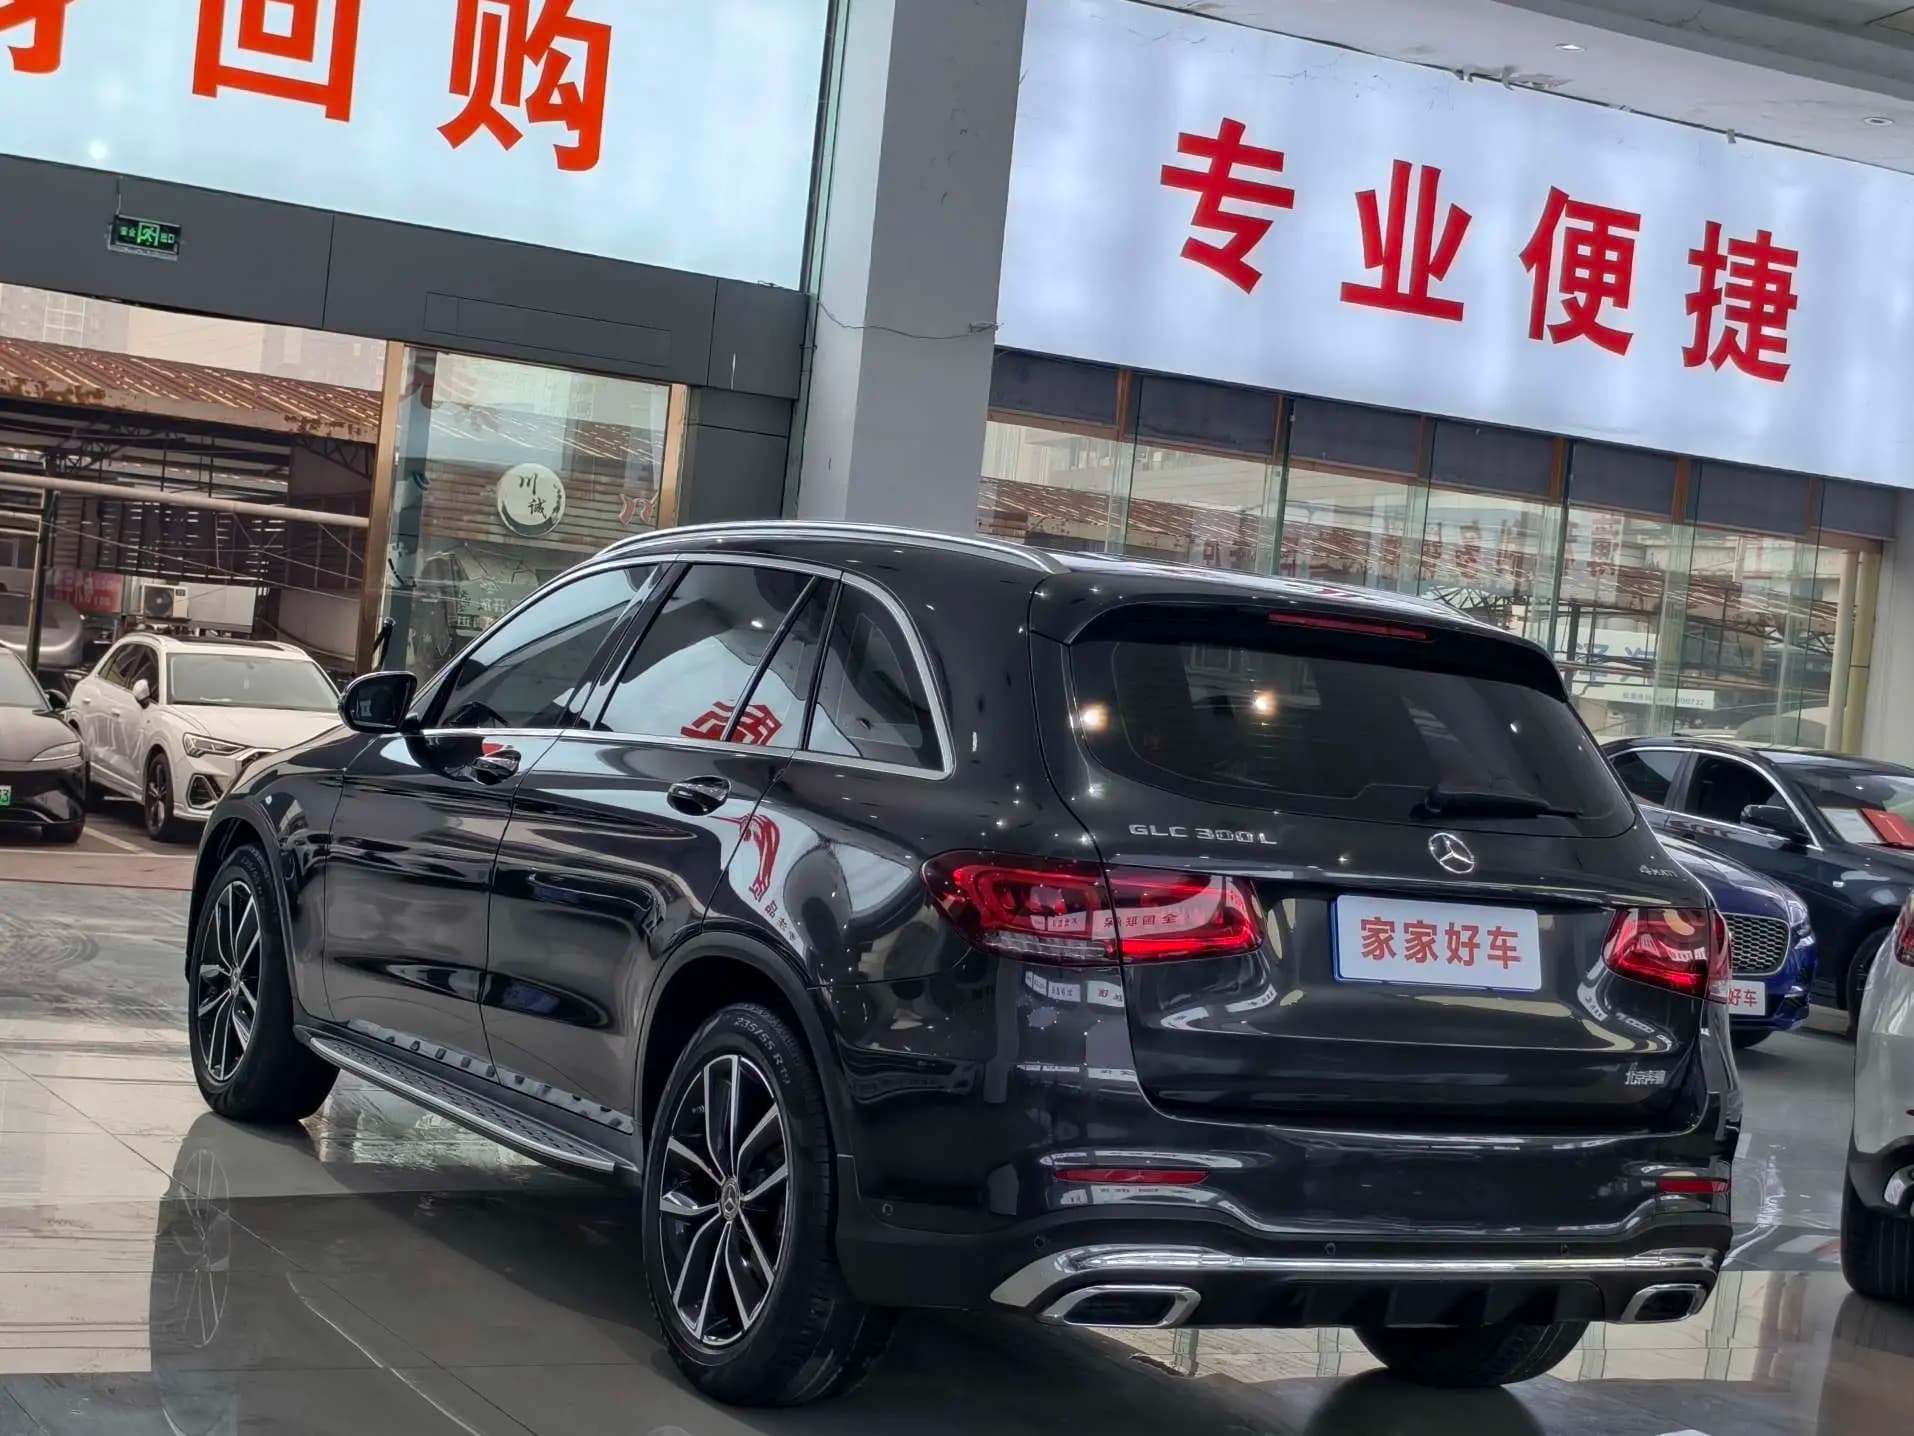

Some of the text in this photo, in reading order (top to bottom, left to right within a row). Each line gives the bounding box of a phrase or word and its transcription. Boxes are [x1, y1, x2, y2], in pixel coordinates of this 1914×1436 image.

[1160, 118, 1799, 382] 专业便捷
[1128, 824, 1188, 838] GLC
[1359, 915, 1522, 970] 家家好车
